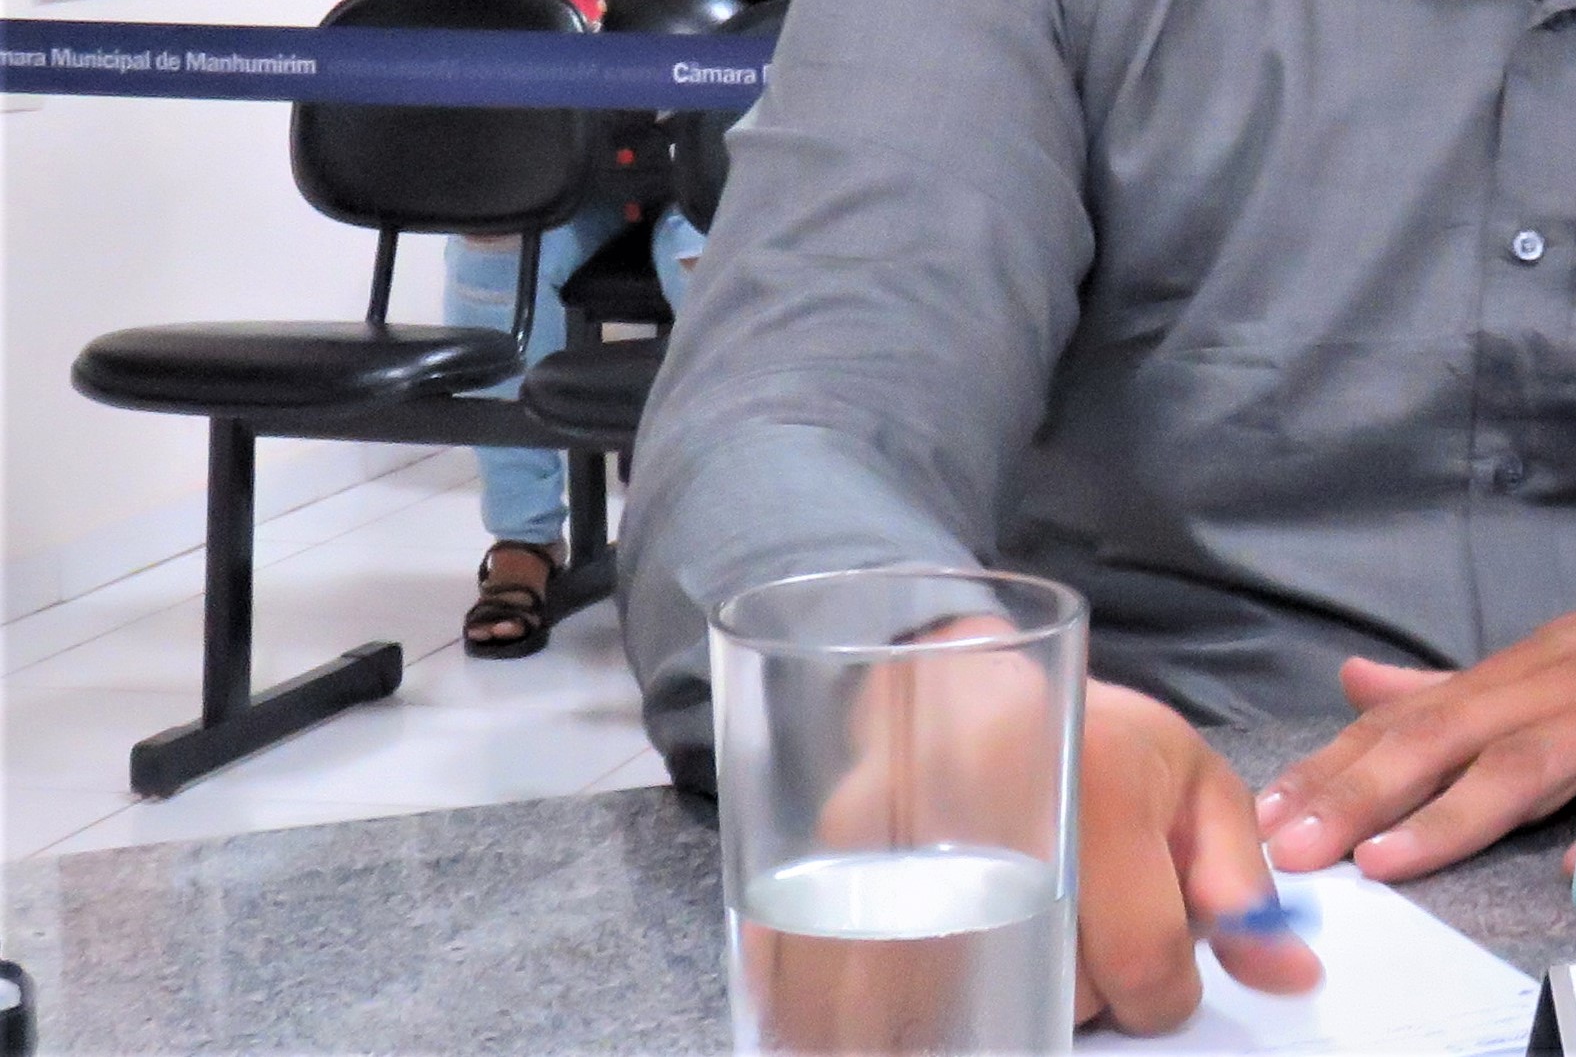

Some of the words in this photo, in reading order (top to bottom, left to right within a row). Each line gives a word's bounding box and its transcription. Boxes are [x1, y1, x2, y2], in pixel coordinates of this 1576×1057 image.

[50, 47, 152, 74] Municipal
[155, 50, 182, 71] de
[185, 50, 317, 74] Manhumirim
